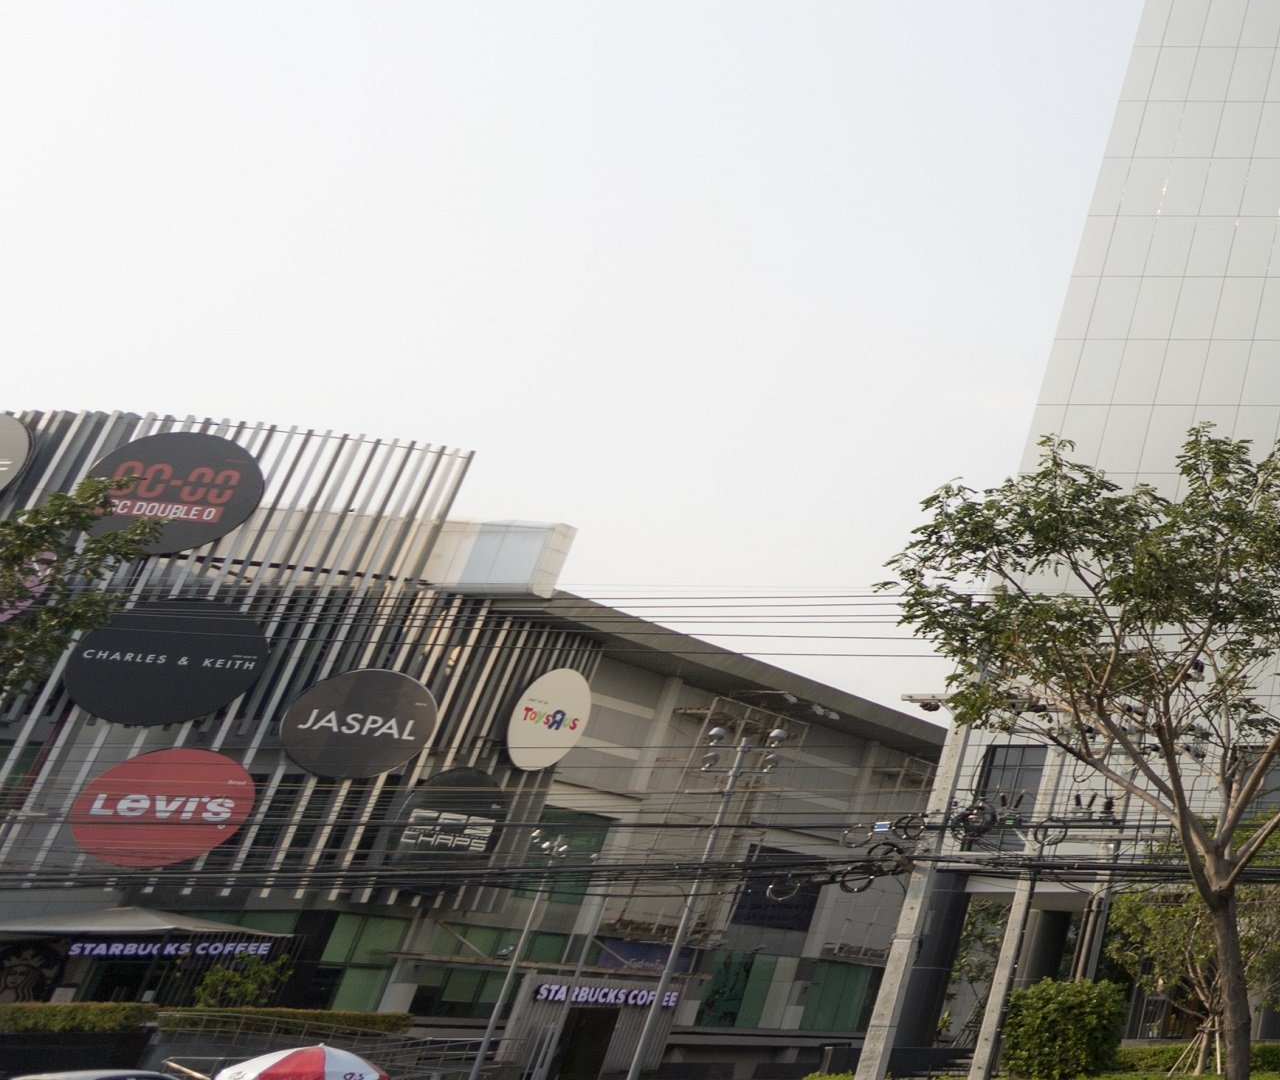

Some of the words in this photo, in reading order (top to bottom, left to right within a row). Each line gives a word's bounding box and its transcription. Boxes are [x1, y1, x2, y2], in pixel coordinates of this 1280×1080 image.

[132, 501, 200, 520] DOUBLE
[82, 649, 168, 665] CHARLES
[178, 656, 190, 666] &
[202, 658, 257, 670] KEITH
[297, 709, 416, 741] JASPAL
[401, 831, 488, 852] CHAPS
[68, 943, 192, 956] STARBUCKS
[195, 942, 272, 956] COFFEE
[627, 989, 679, 1007] COFEE
